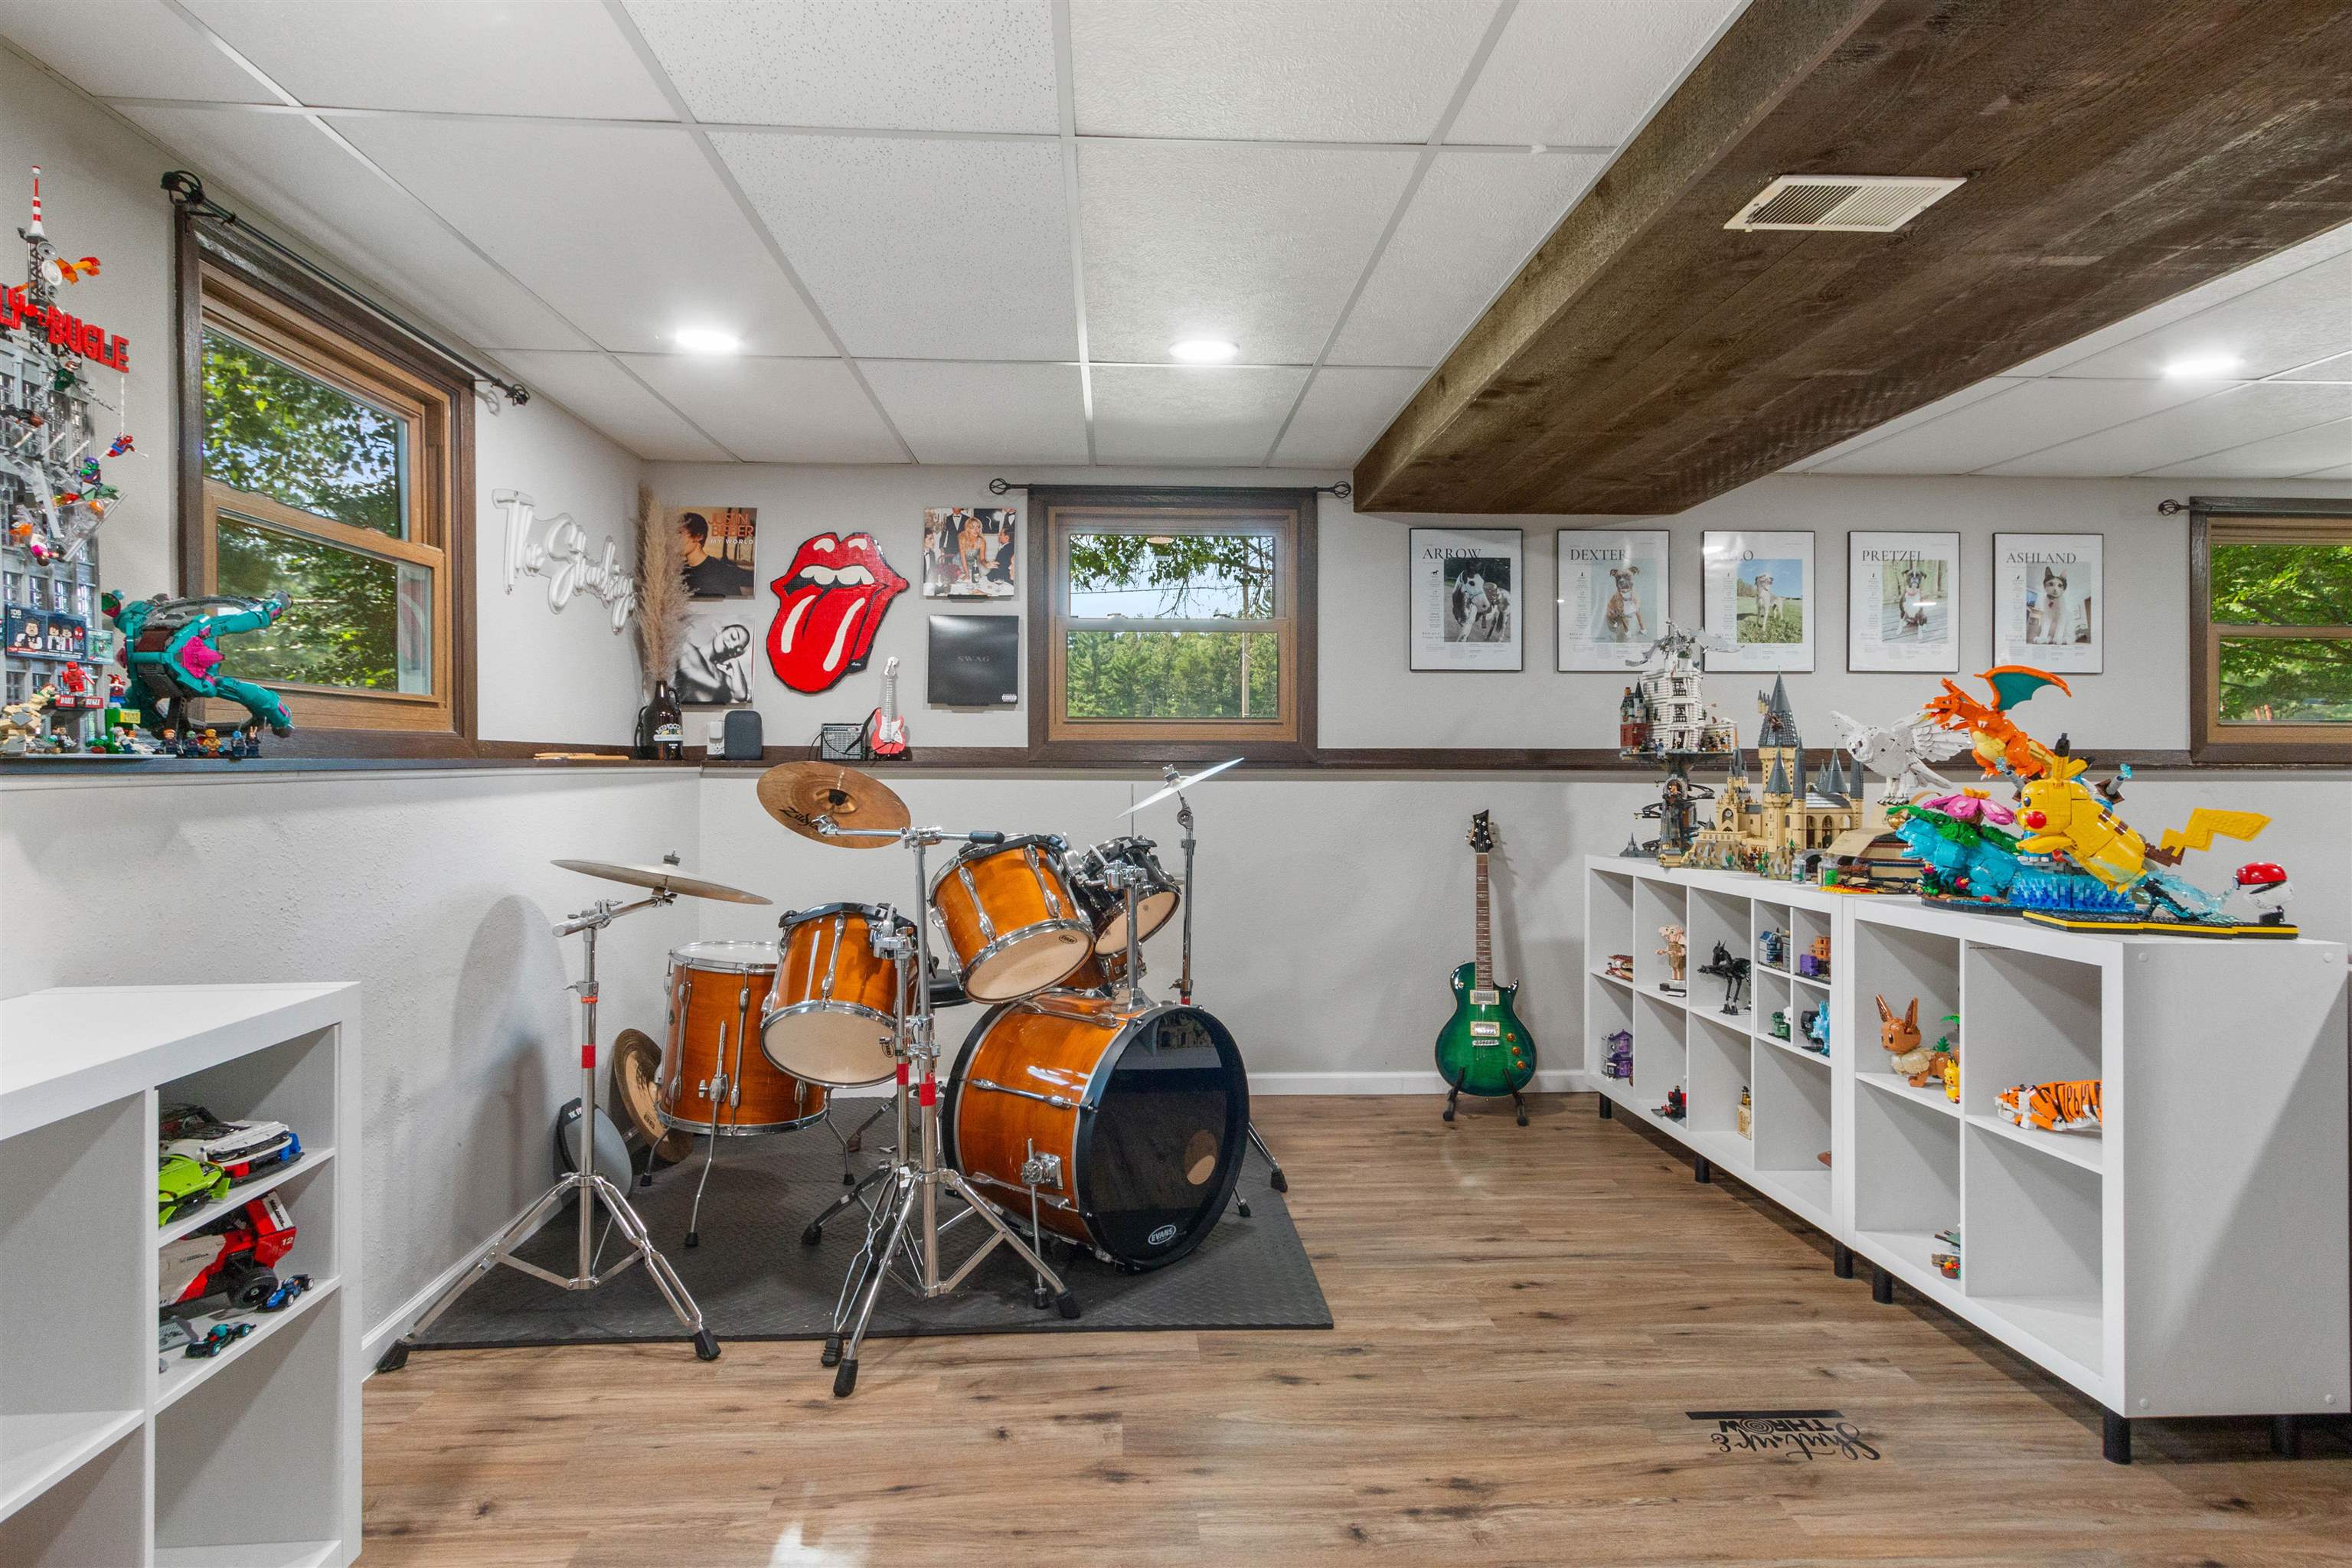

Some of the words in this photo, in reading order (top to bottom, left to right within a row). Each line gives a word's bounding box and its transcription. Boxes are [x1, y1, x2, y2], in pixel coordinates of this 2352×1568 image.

[48, 305, 129, 374] BUGLE
[707, 512, 749, 526] JUSTIN
[711, 524, 754, 537] BIEBER
[1423, 548, 1481, 560] ARROW
[1861, 550, 1926, 561] PRETZEL
[2006, 552, 2076, 564] ASHLAND
[281, 1236, 294, 1246] 12
[1152, 1227, 1174, 1242] EVANS
[1718, 1419, 1836, 1435] THROW
